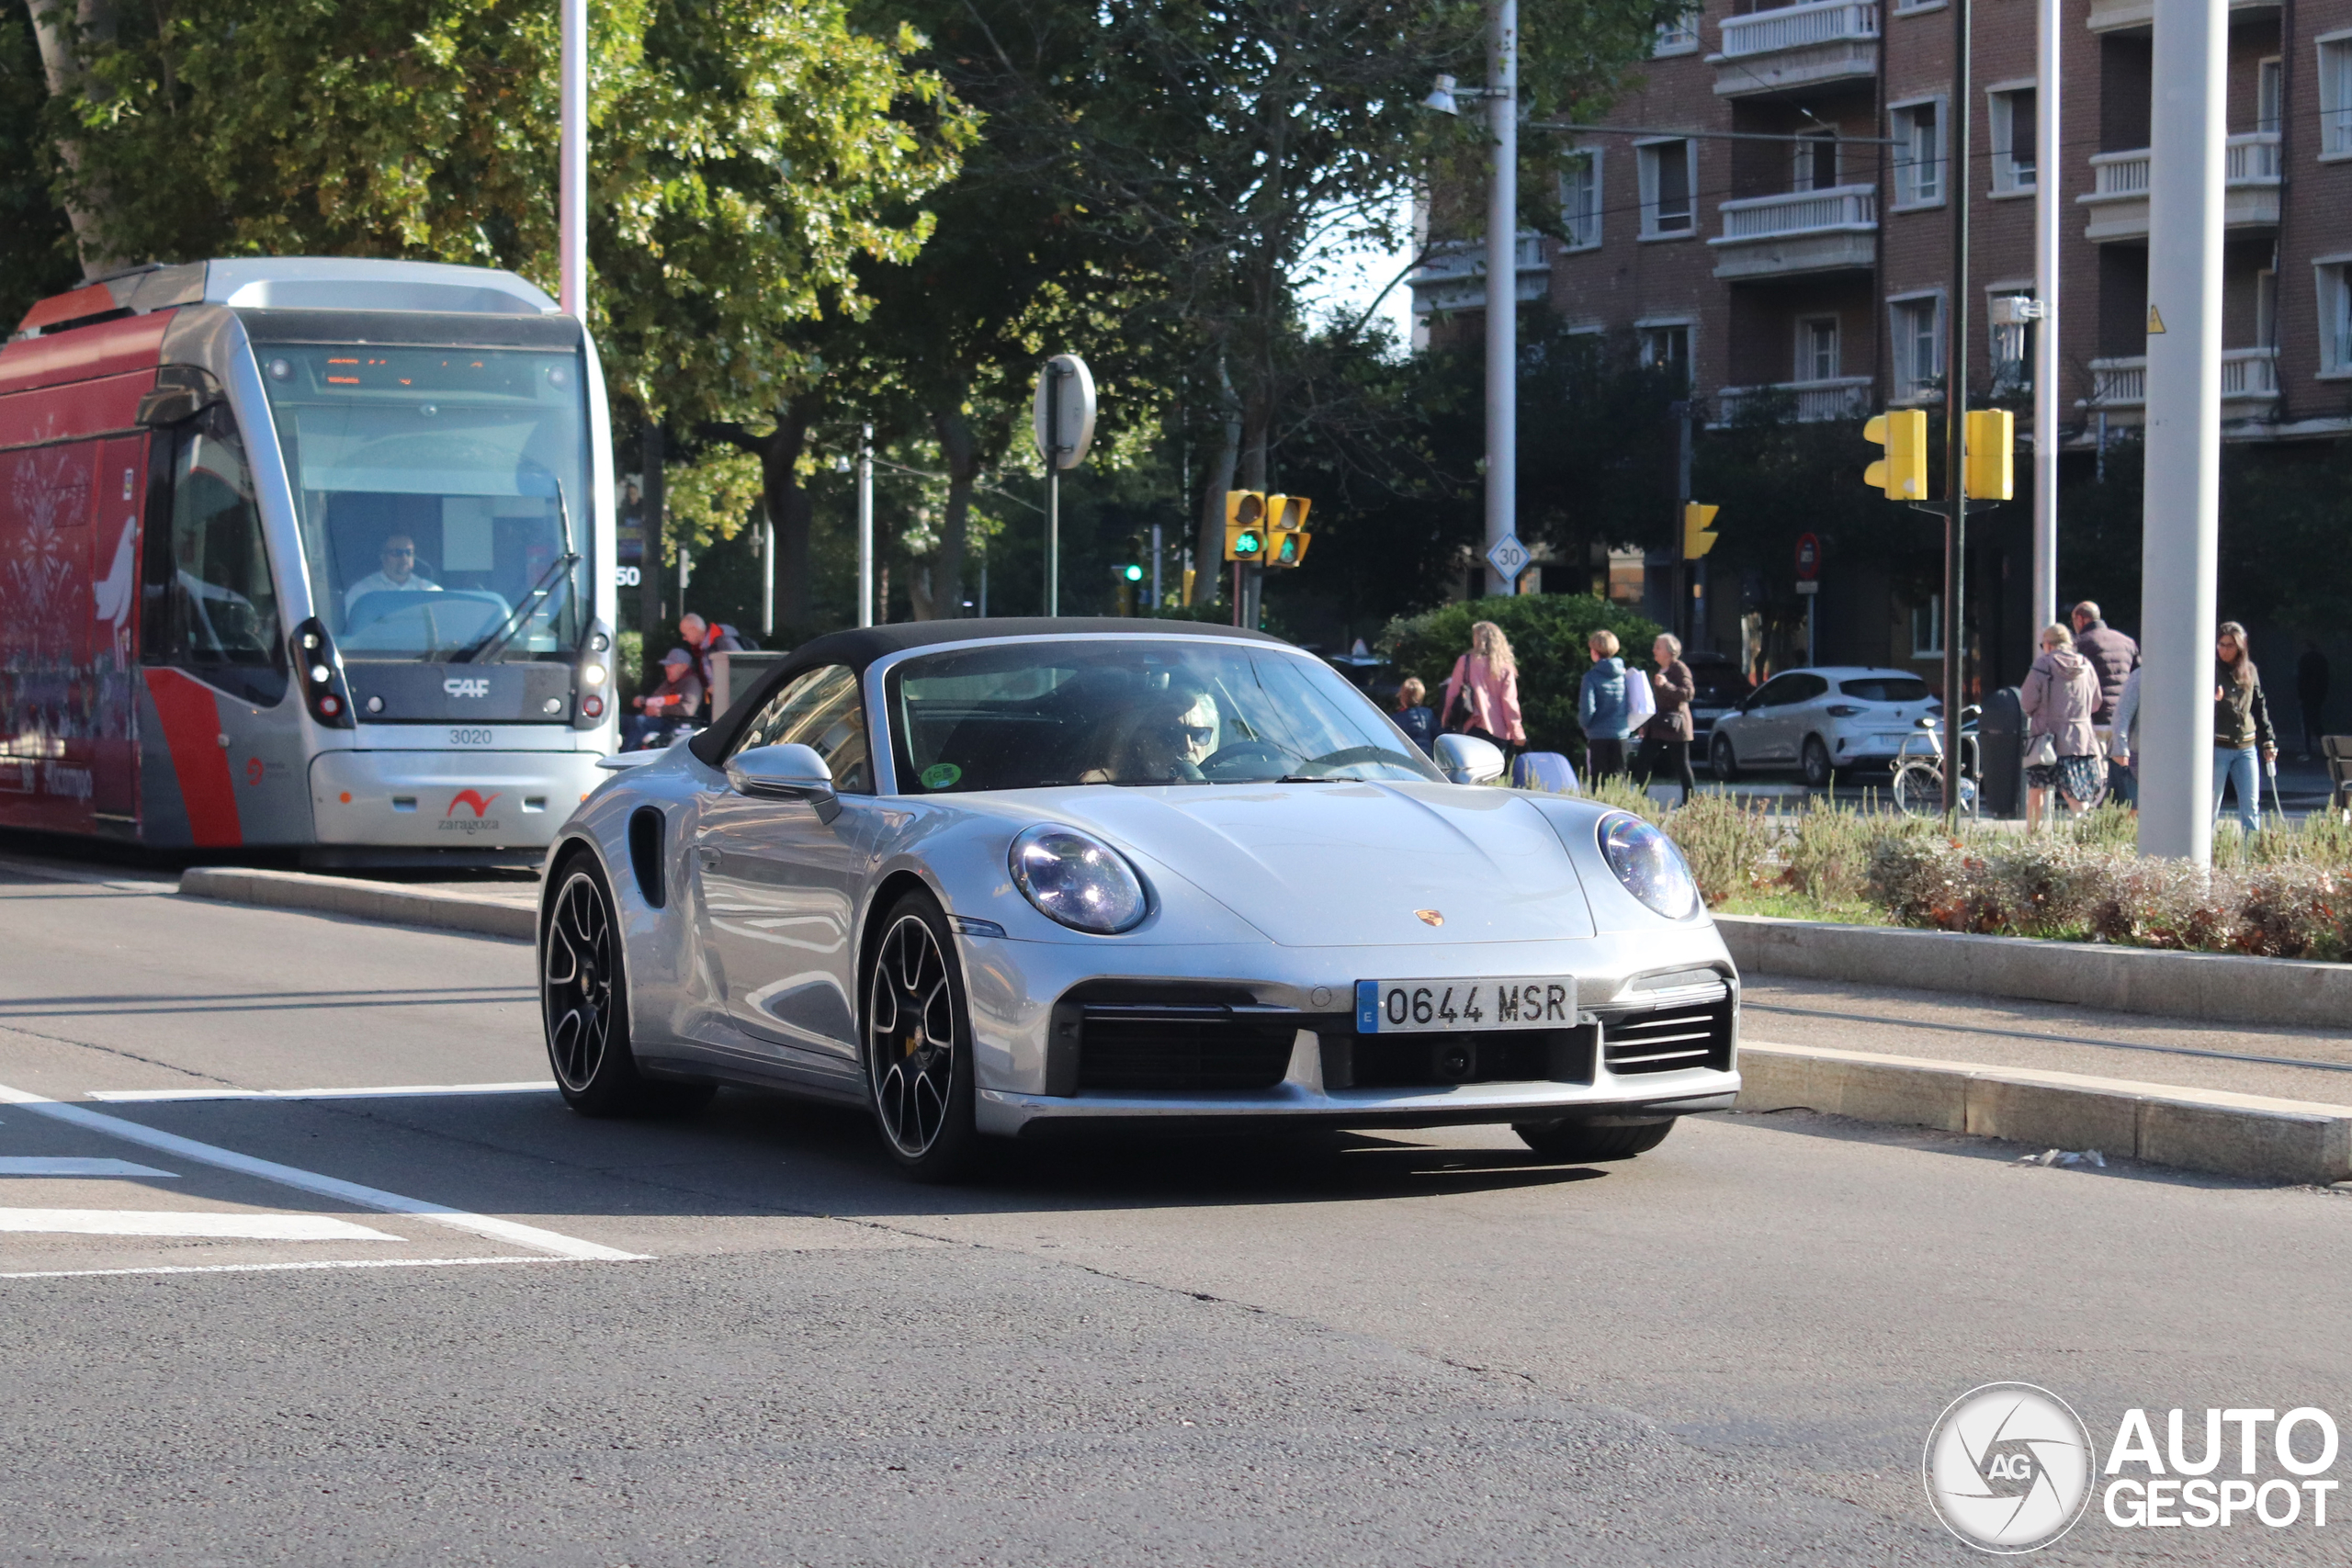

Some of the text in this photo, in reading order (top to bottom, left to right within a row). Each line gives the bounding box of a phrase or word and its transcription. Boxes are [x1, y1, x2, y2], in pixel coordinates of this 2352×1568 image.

[1499, 548, 1520, 566] 30
[443, 679, 490, 697] CAF
[450, 729, 492, 745] 3020
[438, 819, 500, 836] zaragoza
[1385, 984, 1566, 1025] 0644 MSR
[1363, 1011, 1373, 1023] E
